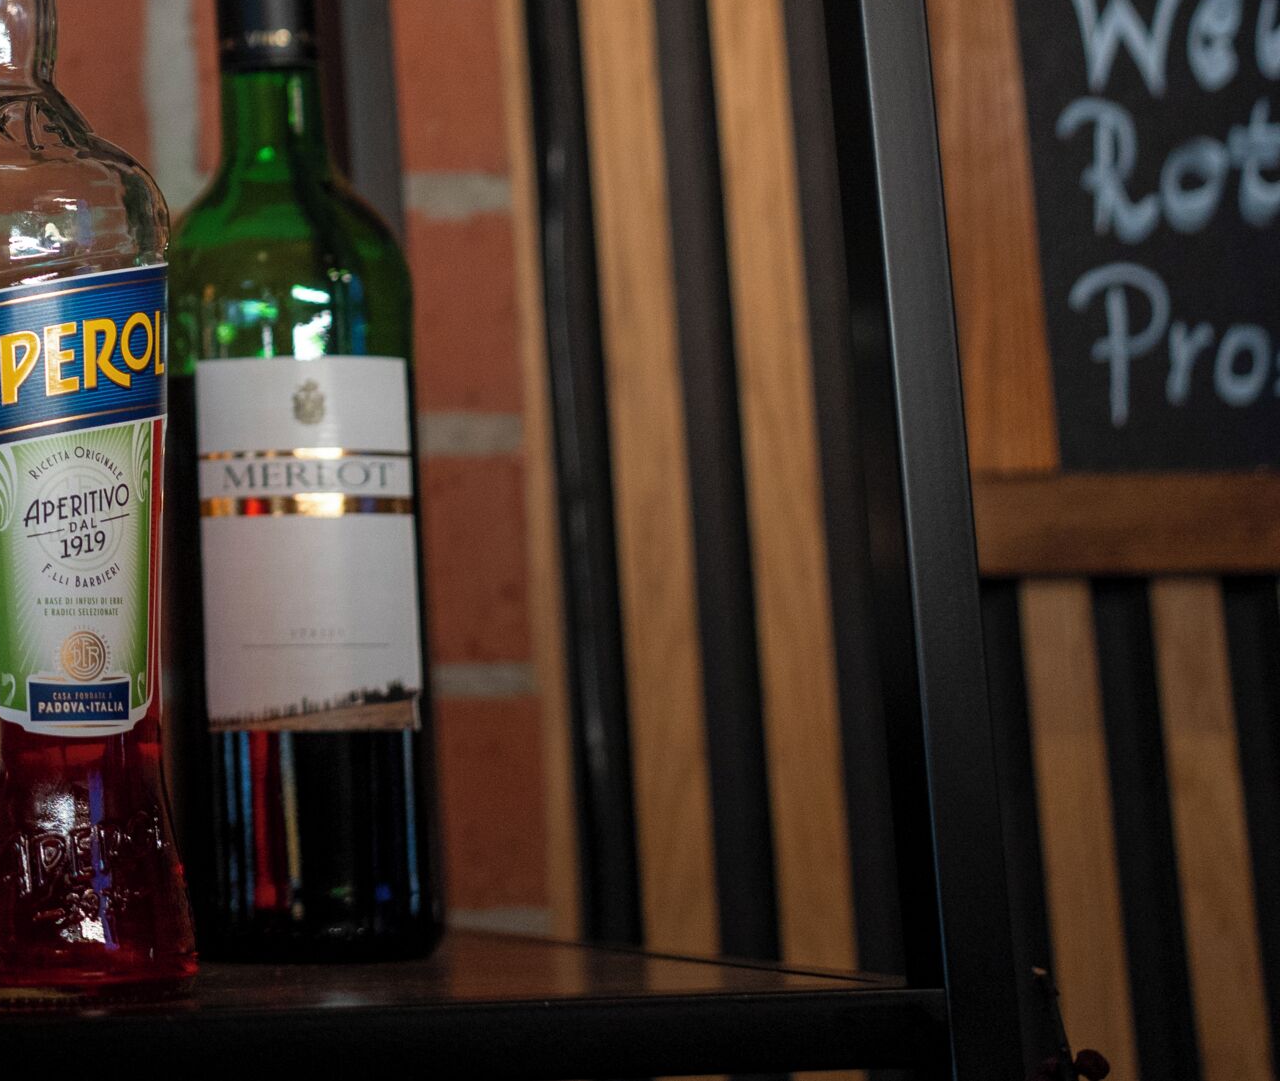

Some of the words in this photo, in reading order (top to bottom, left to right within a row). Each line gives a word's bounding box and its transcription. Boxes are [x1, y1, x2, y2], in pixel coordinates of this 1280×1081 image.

[1068, 261, 1280, 428] Pro
[29, 450, 70, 480] RICETTA
[74, 446, 123, 481] ORIGINALE
[222, 461, 394, 489] MERLOT
[24, 483, 130, 527] APERITIVO
[69, 517, 98, 533] DAL
[60, 530, 106, 559] 1919
[75, 562, 121, 588] BARBIERI
[44, 597, 61, 605] BASE
[65, 597, 73, 605] DI
[76, 597, 98, 605] INFUSI
[100, 597, 107, 605] DI
[51, 608, 76, 617] RADICI
[78, 607, 119, 617] SELEZIONATE
